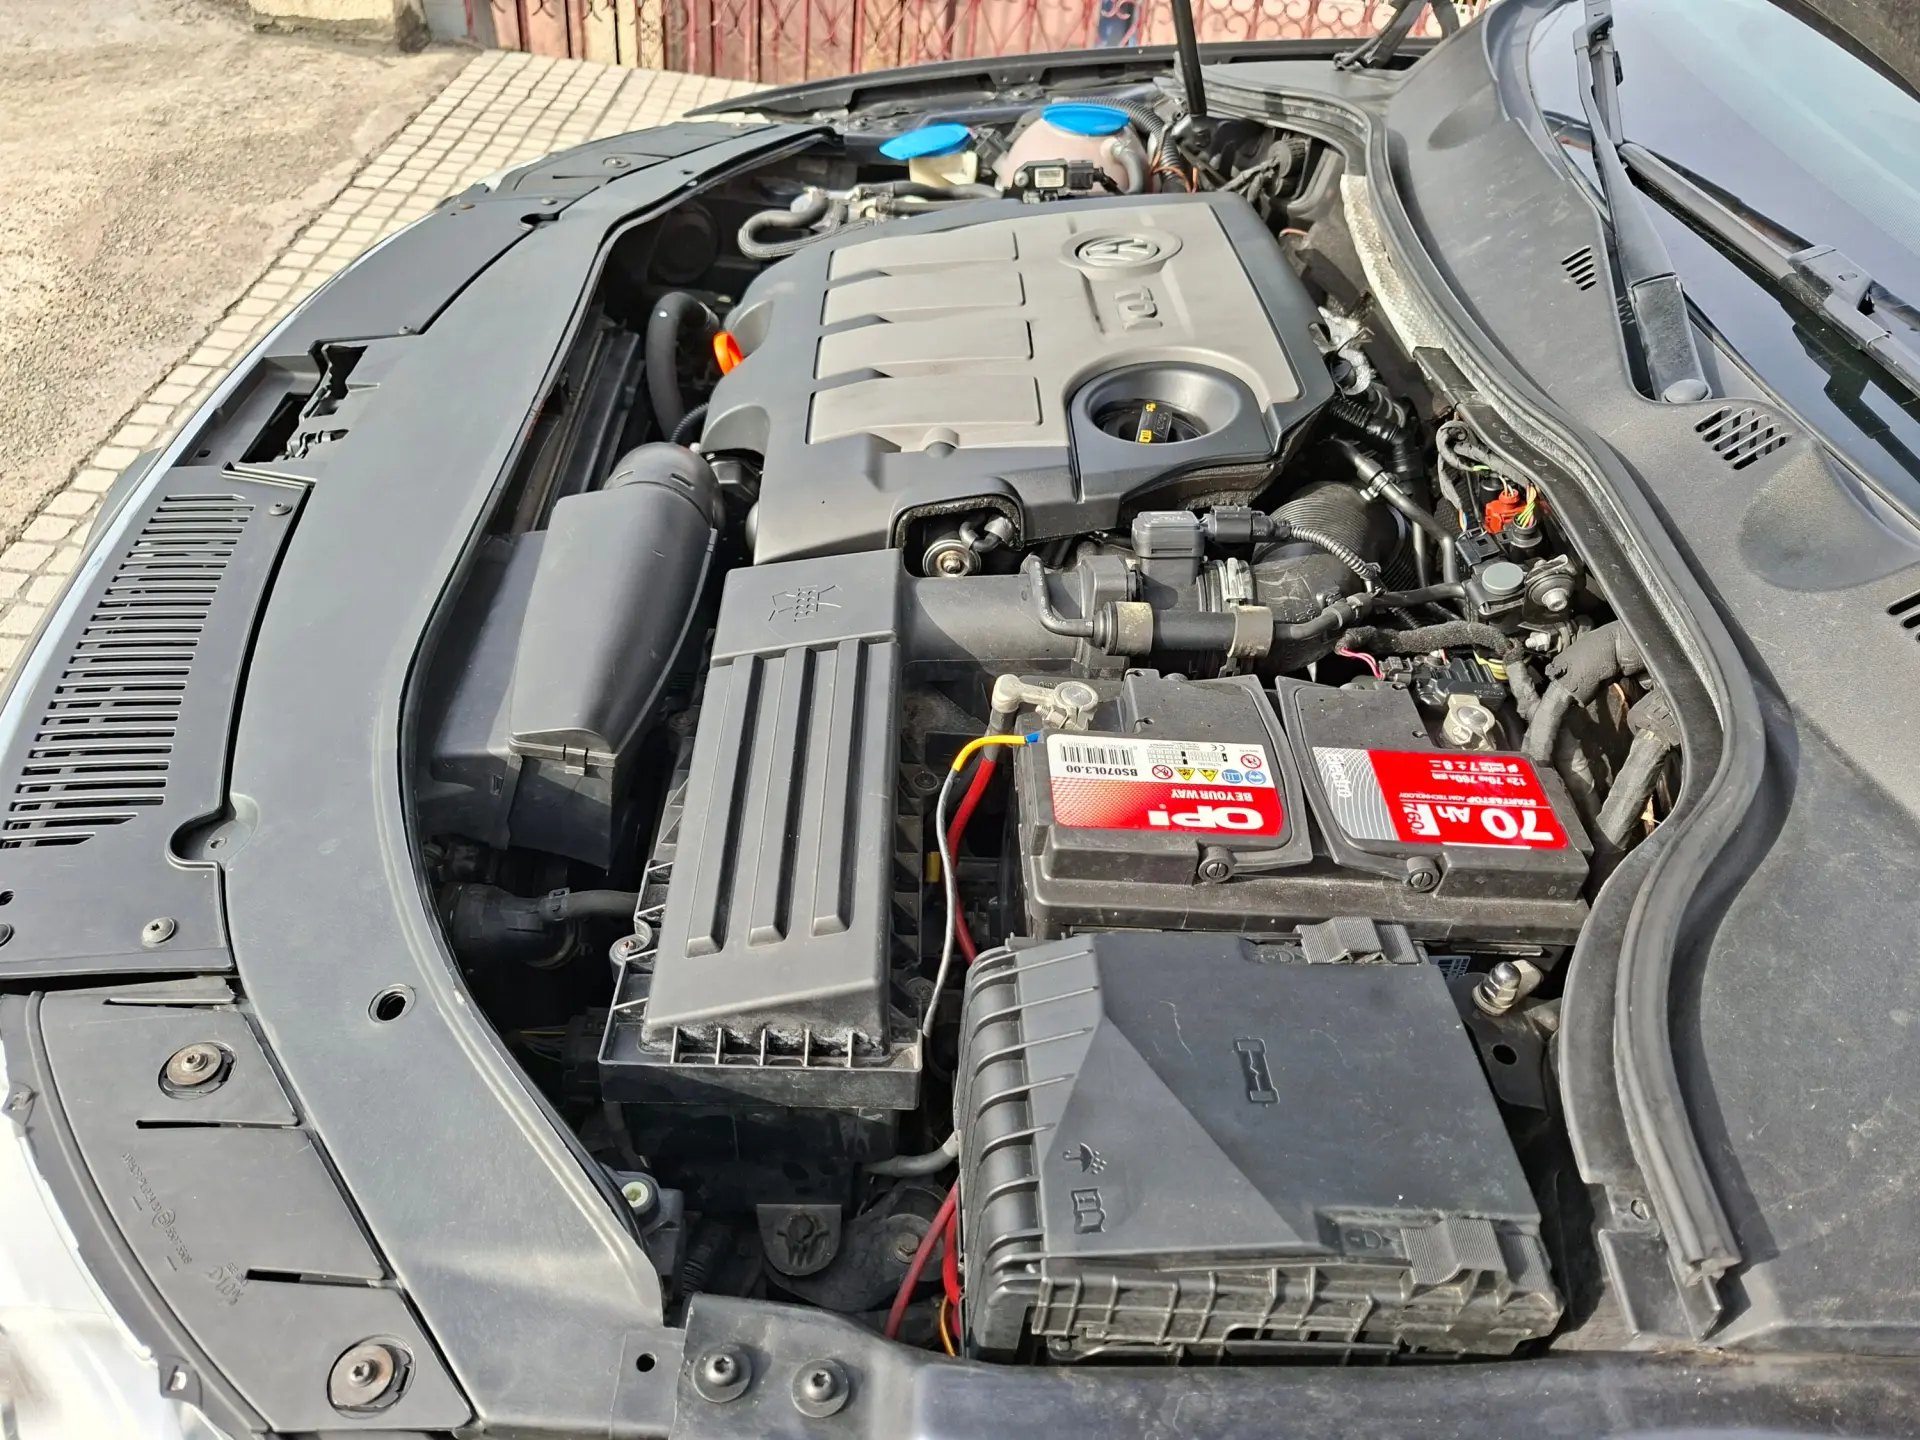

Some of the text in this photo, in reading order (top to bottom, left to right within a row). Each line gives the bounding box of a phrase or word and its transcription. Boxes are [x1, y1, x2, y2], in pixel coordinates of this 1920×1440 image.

[1113, 285, 1164, 331] TDI
[1066, 764, 1139, 777] BS070L3.00
[1171, 788, 1254, 802] BE YOUR WAY
[1436, 805, 1554, 841] 70 Ah
